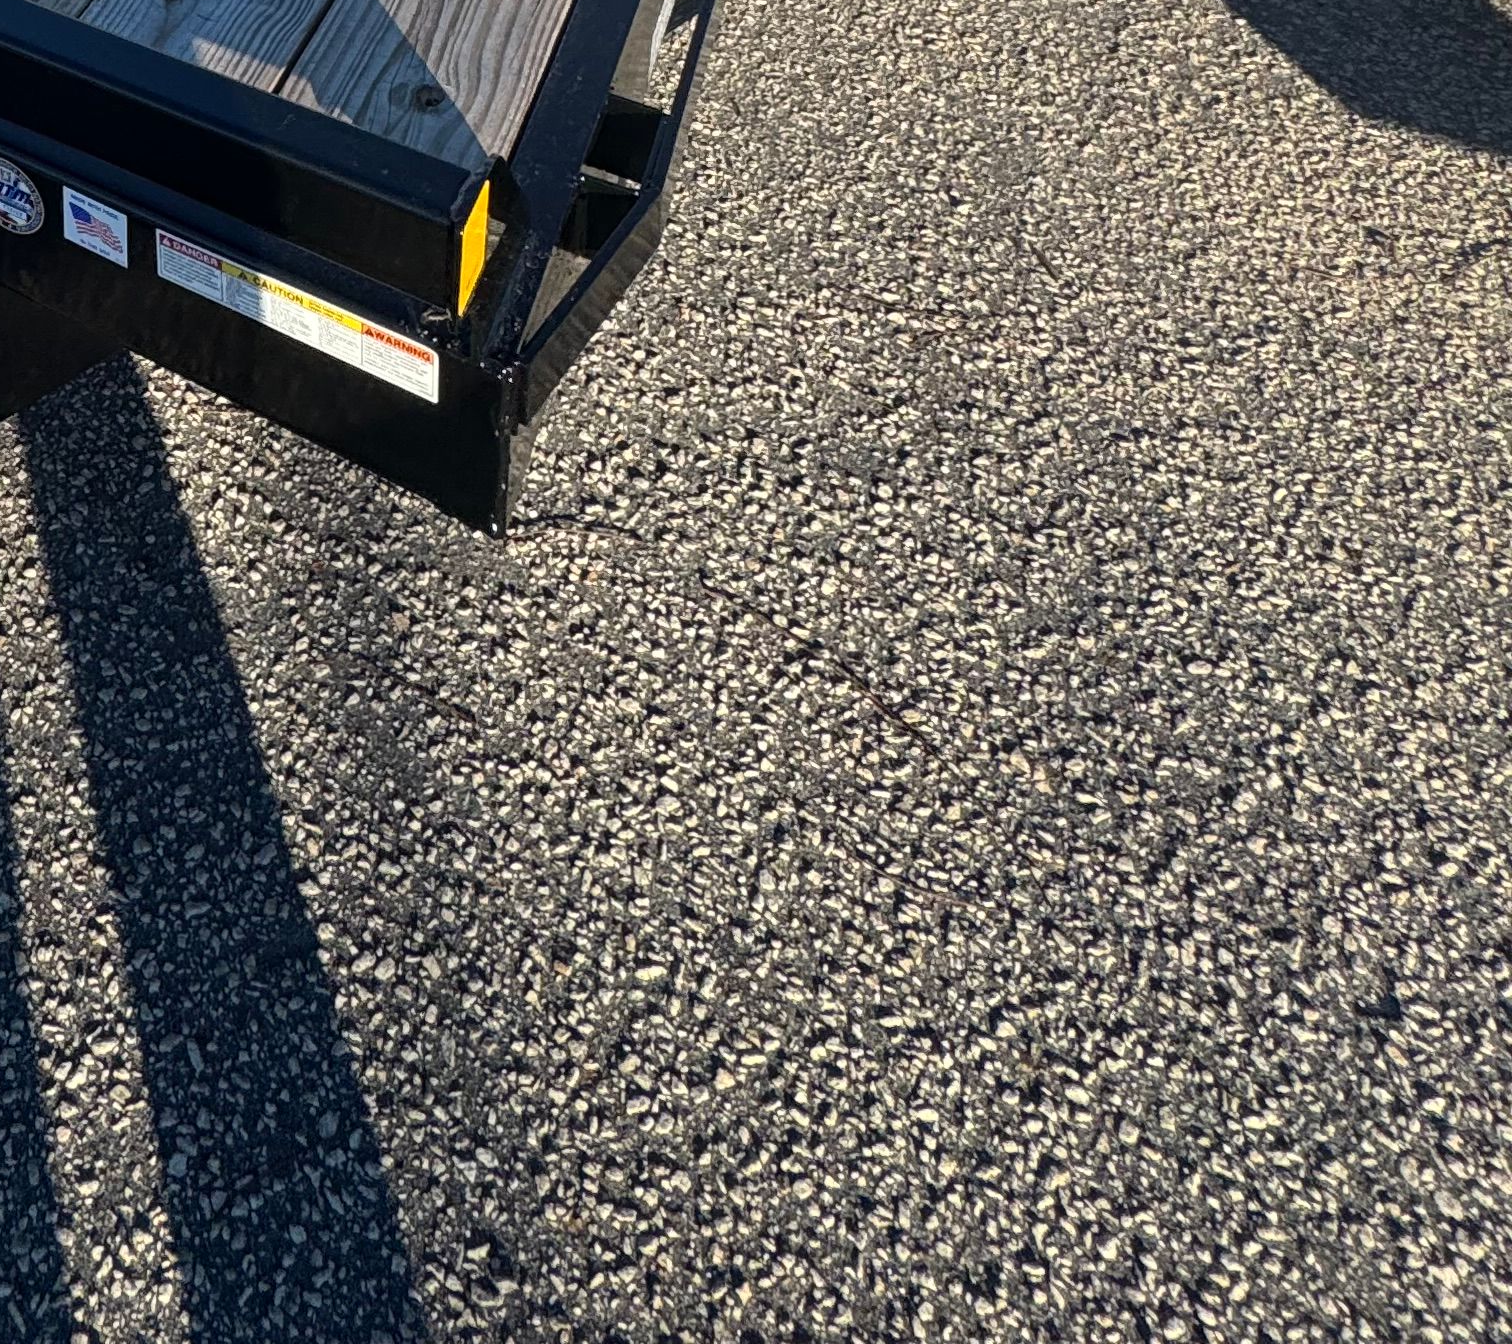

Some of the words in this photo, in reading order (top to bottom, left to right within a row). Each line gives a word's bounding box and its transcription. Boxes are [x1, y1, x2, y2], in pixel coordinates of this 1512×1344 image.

[172, 241, 219, 268] DANGER
[254, 276, 304, 305] CAUTION
[371, 328, 431, 362] WARNING
